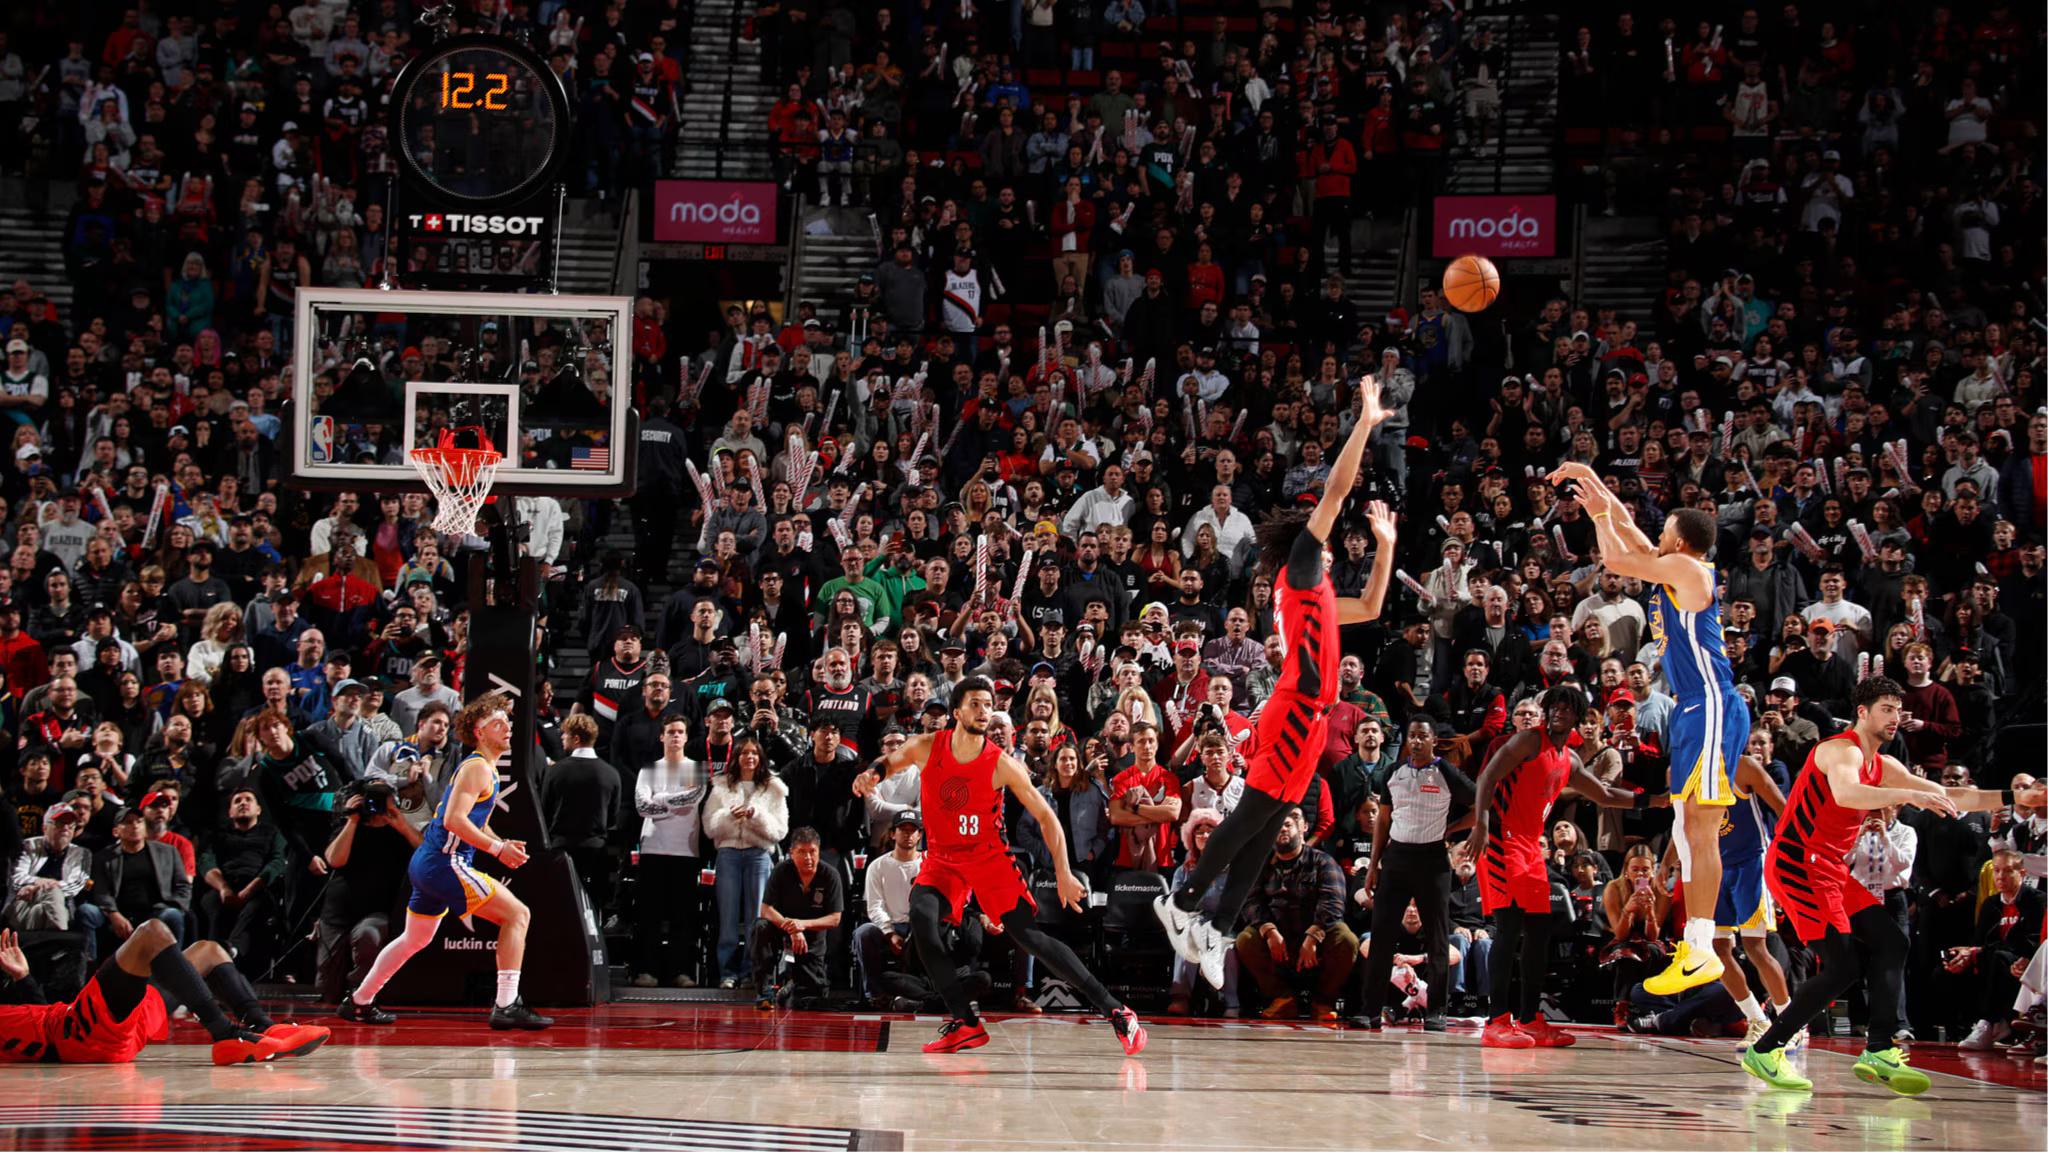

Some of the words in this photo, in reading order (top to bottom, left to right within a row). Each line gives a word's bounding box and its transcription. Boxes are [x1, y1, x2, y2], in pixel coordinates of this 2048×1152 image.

[441, 71, 508, 110] 12.2
[671, 199, 759, 224] moda
[446, 214, 543, 236] TISSOT
[722, 227, 760, 236] HEALTH
[1448, 213, 1538, 239] moda
[1499, 241, 1538, 249] HEALTH
[951, 282, 975, 291] BLAZERS
[641, 429, 672, 444] SECURITY
[49, 535, 83, 546] BLAZERS
[817, 699, 860, 712] PORTLAND
[282, 755, 323, 791] PDX
[958, 813, 979, 836] 33
[1113, 883, 1162, 892] ticketmaster
[443, 937, 483, 951] luckin
